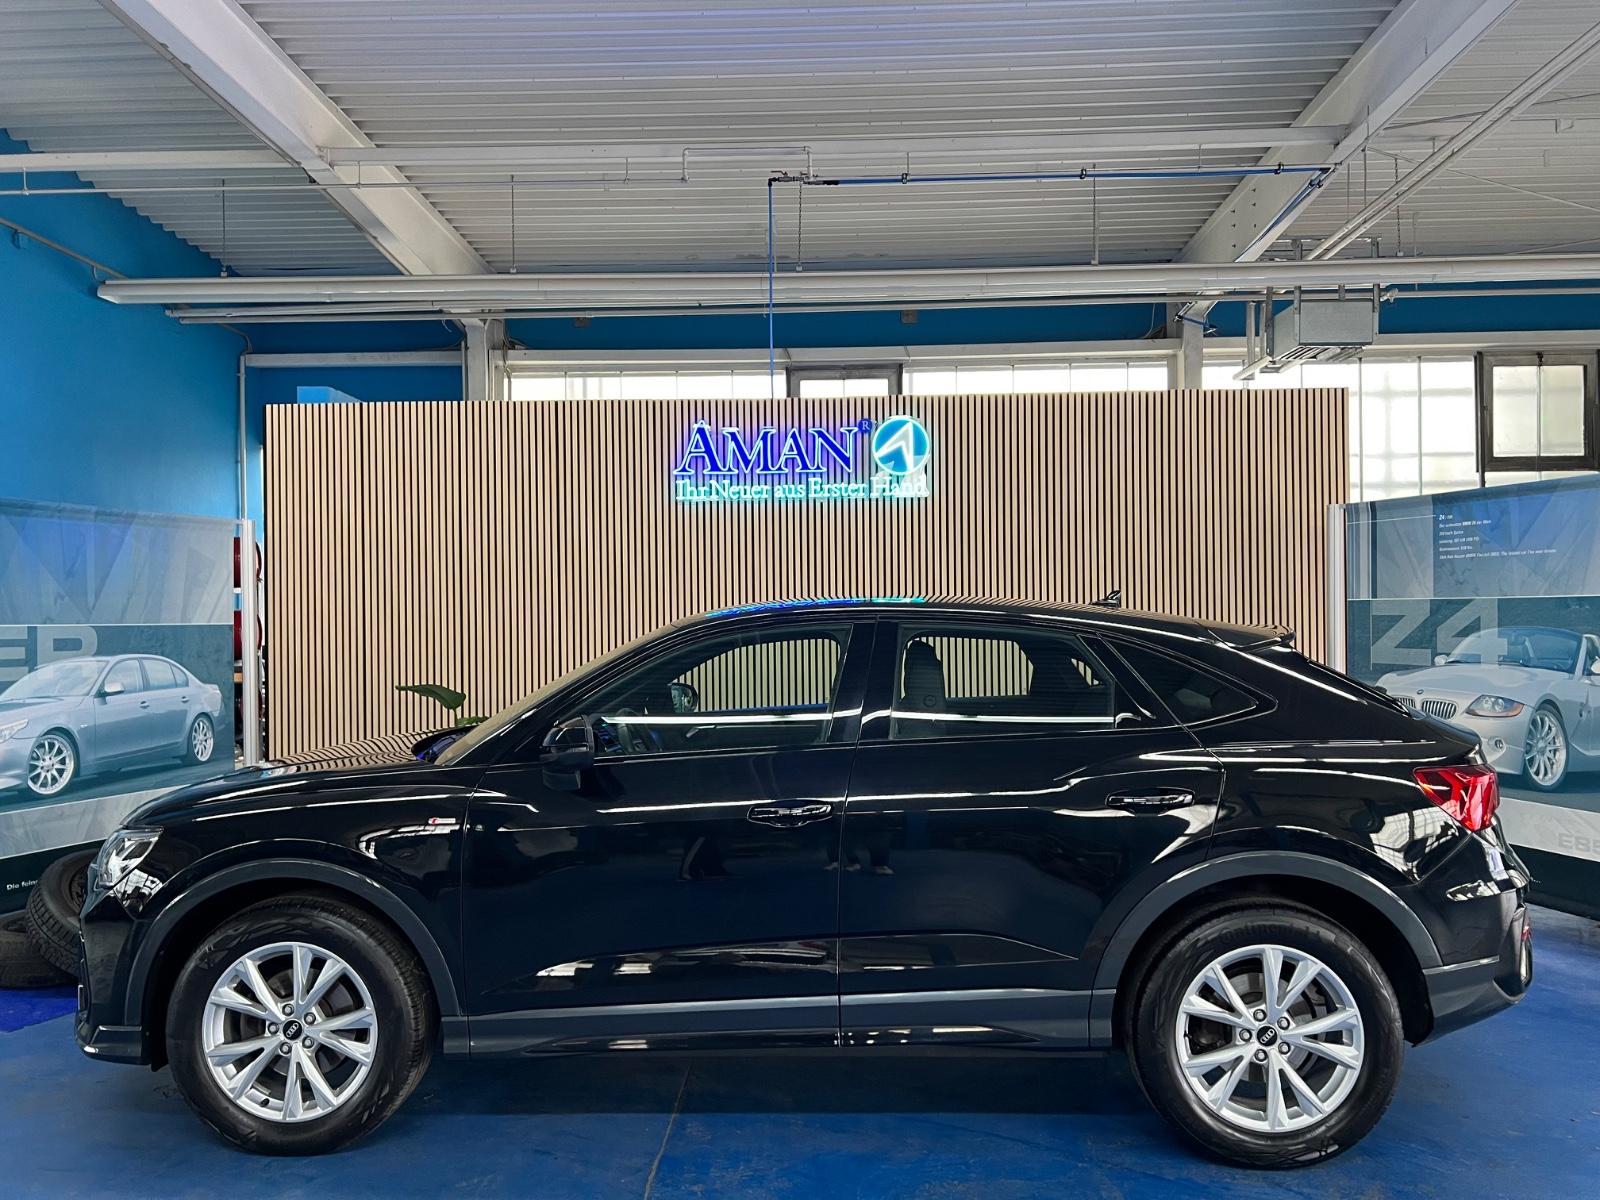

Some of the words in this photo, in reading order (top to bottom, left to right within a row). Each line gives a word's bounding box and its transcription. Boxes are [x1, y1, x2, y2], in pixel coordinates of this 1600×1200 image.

[676, 479, 708, 500] Ihr
[709, 480, 770, 499] Neuer
[774, 482, 806, 498] aus
[808, 477, 868, 498] Erster
[1371, 599, 1508, 667] Z4
